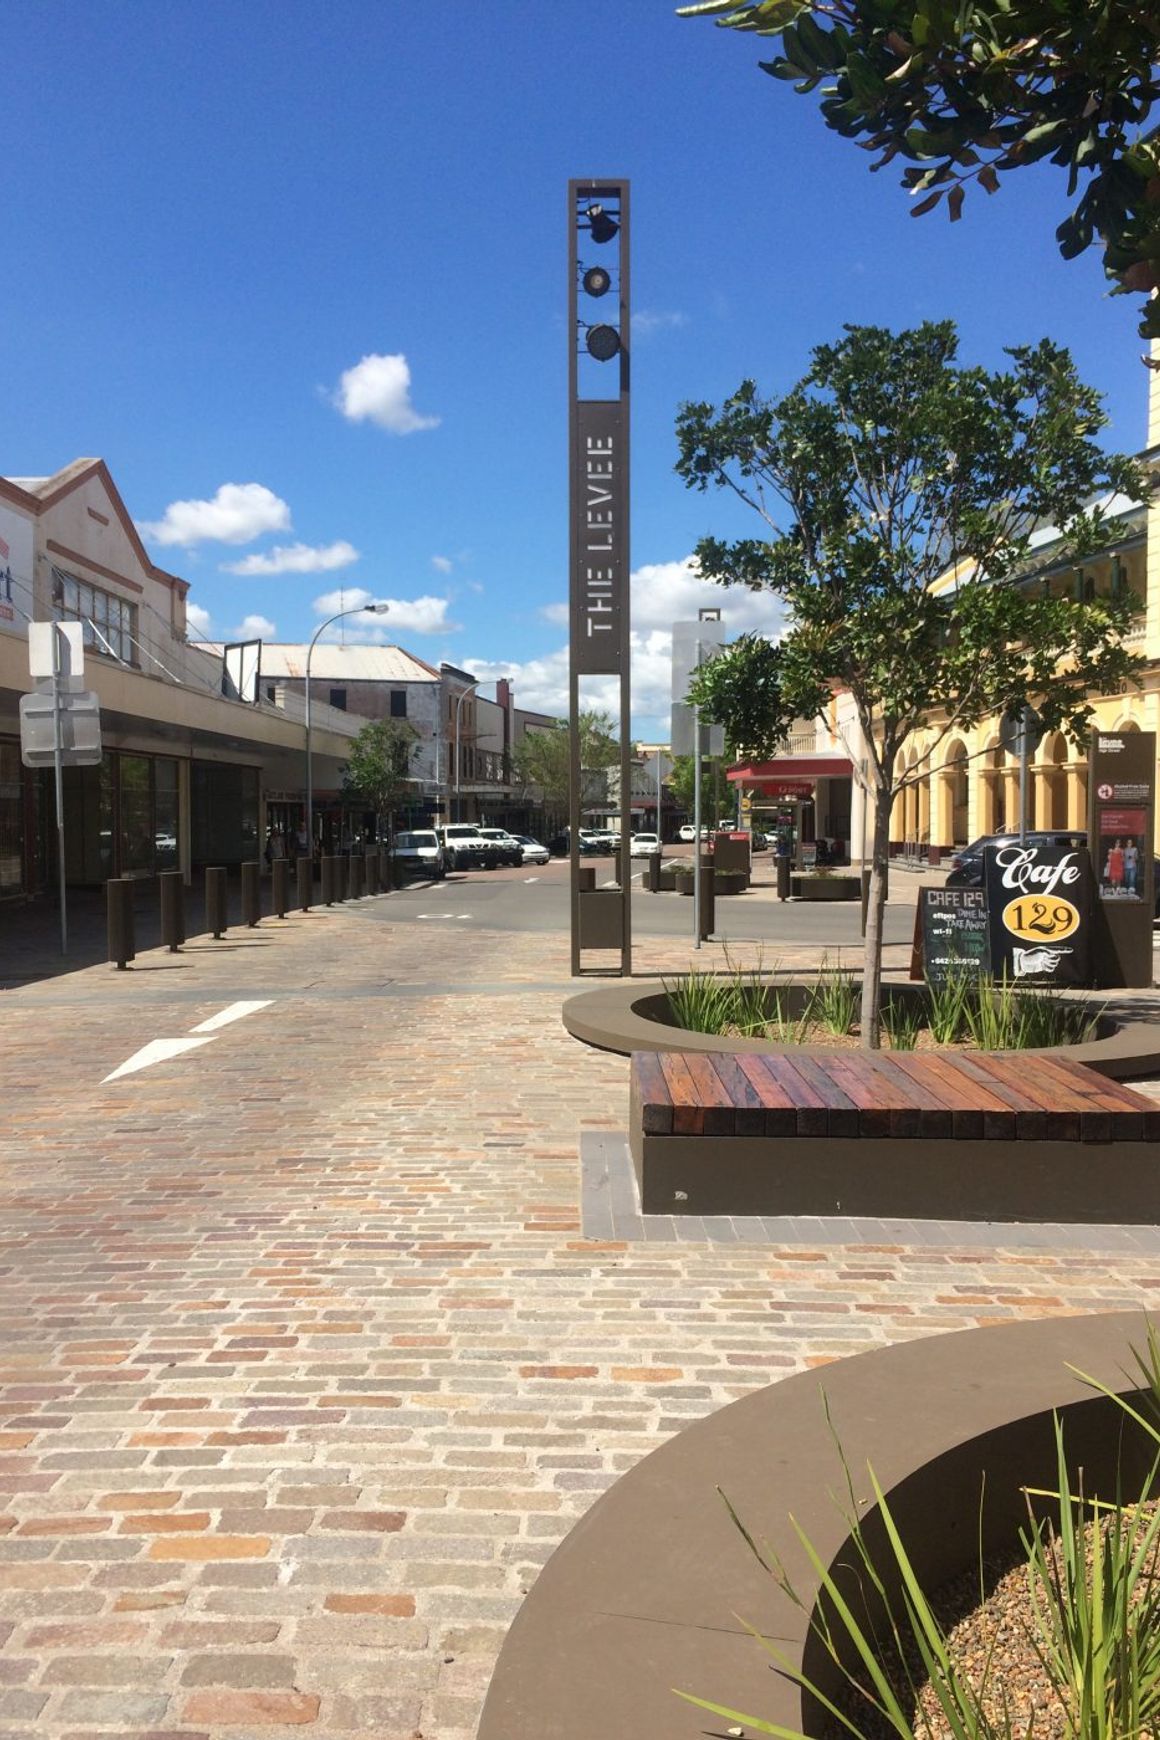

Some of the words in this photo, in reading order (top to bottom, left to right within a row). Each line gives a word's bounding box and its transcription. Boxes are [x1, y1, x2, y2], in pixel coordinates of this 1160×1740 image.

[587, 436, 613, 551] LEVEE
[587, 567, 613, 637] THE
[995, 847, 1081, 895] Cafe
[927, 890, 960, 907] CAFE
[963, 892, 985, 908] 129
[932, 912, 956, 921] eftpos
[1012, 902, 1073, 935] 129
